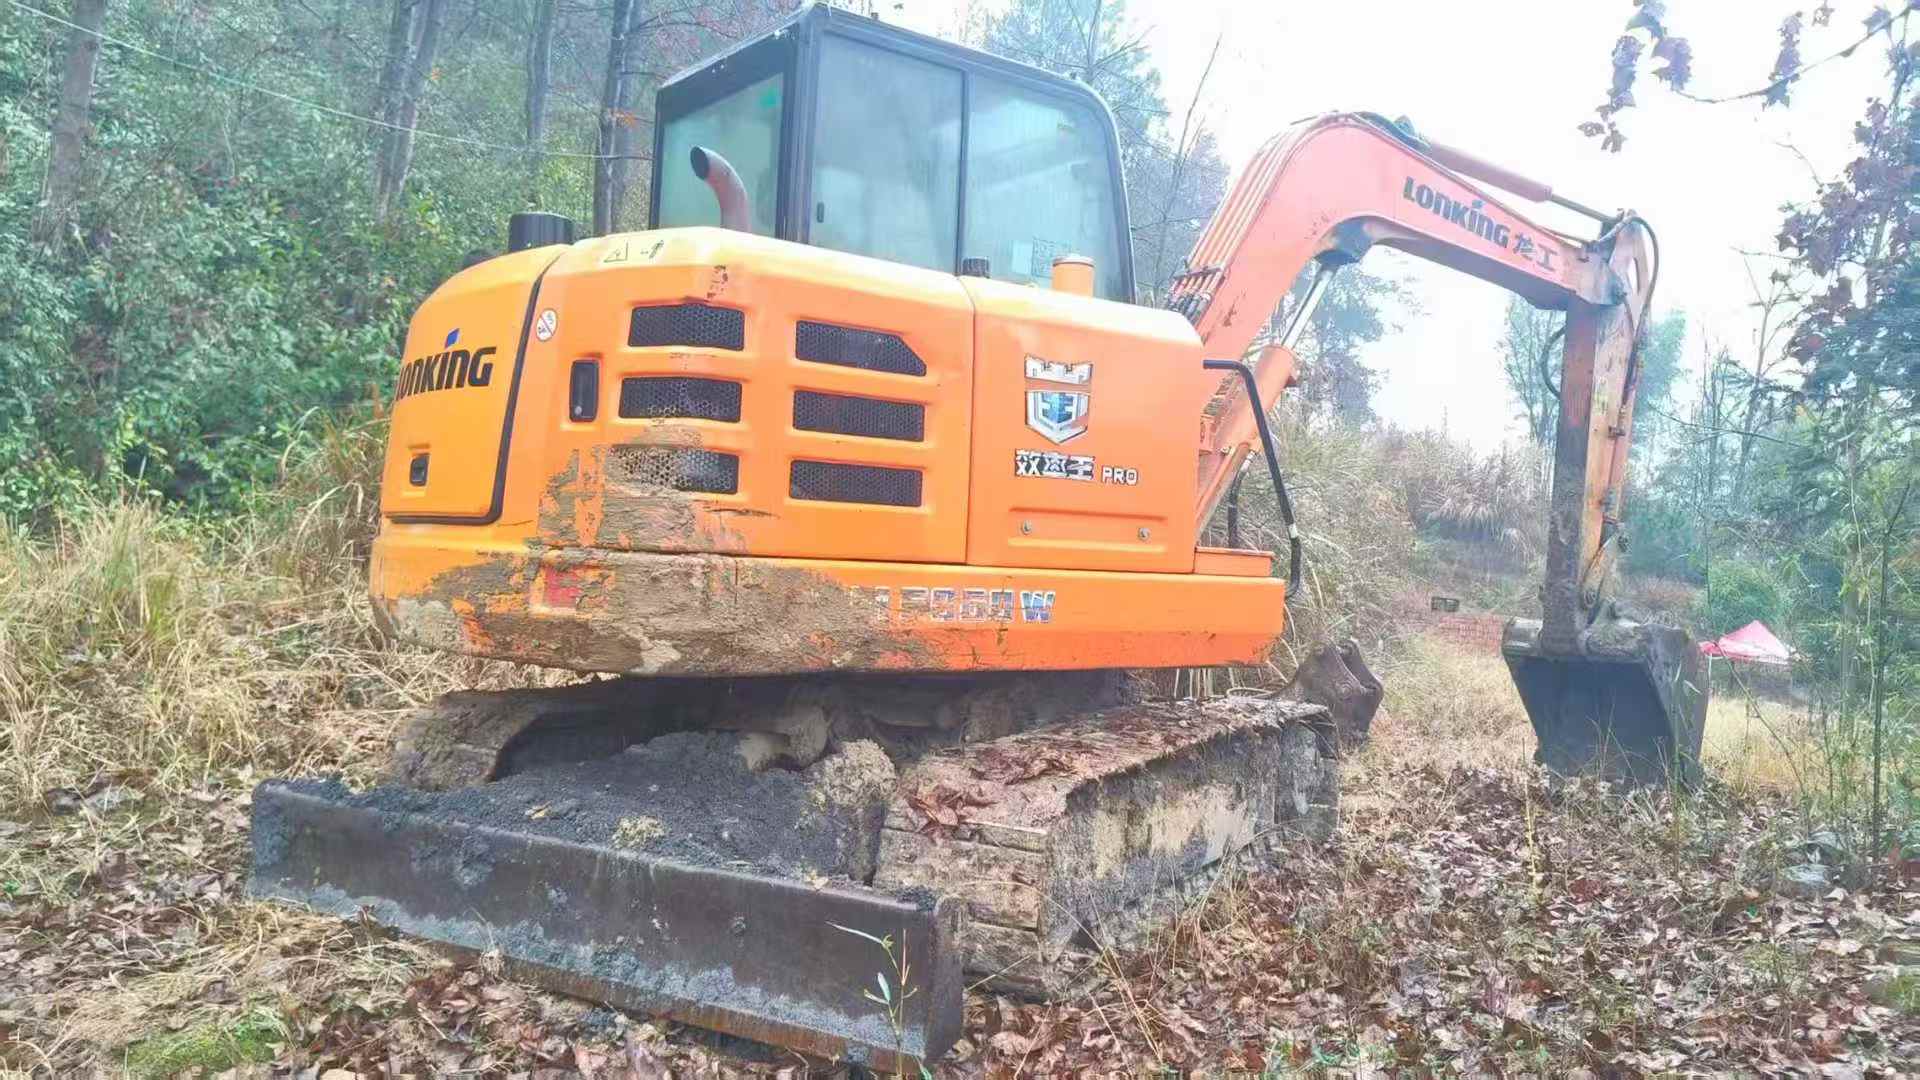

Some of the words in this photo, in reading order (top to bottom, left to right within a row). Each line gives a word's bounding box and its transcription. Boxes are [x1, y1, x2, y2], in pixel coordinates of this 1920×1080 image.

[1402, 176, 1511, 249] LONKING
[1512, 232, 1558, 272] 龙工
[396, 328, 497, 401] ONKING
[1101, 465, 1139, 486] PRO
